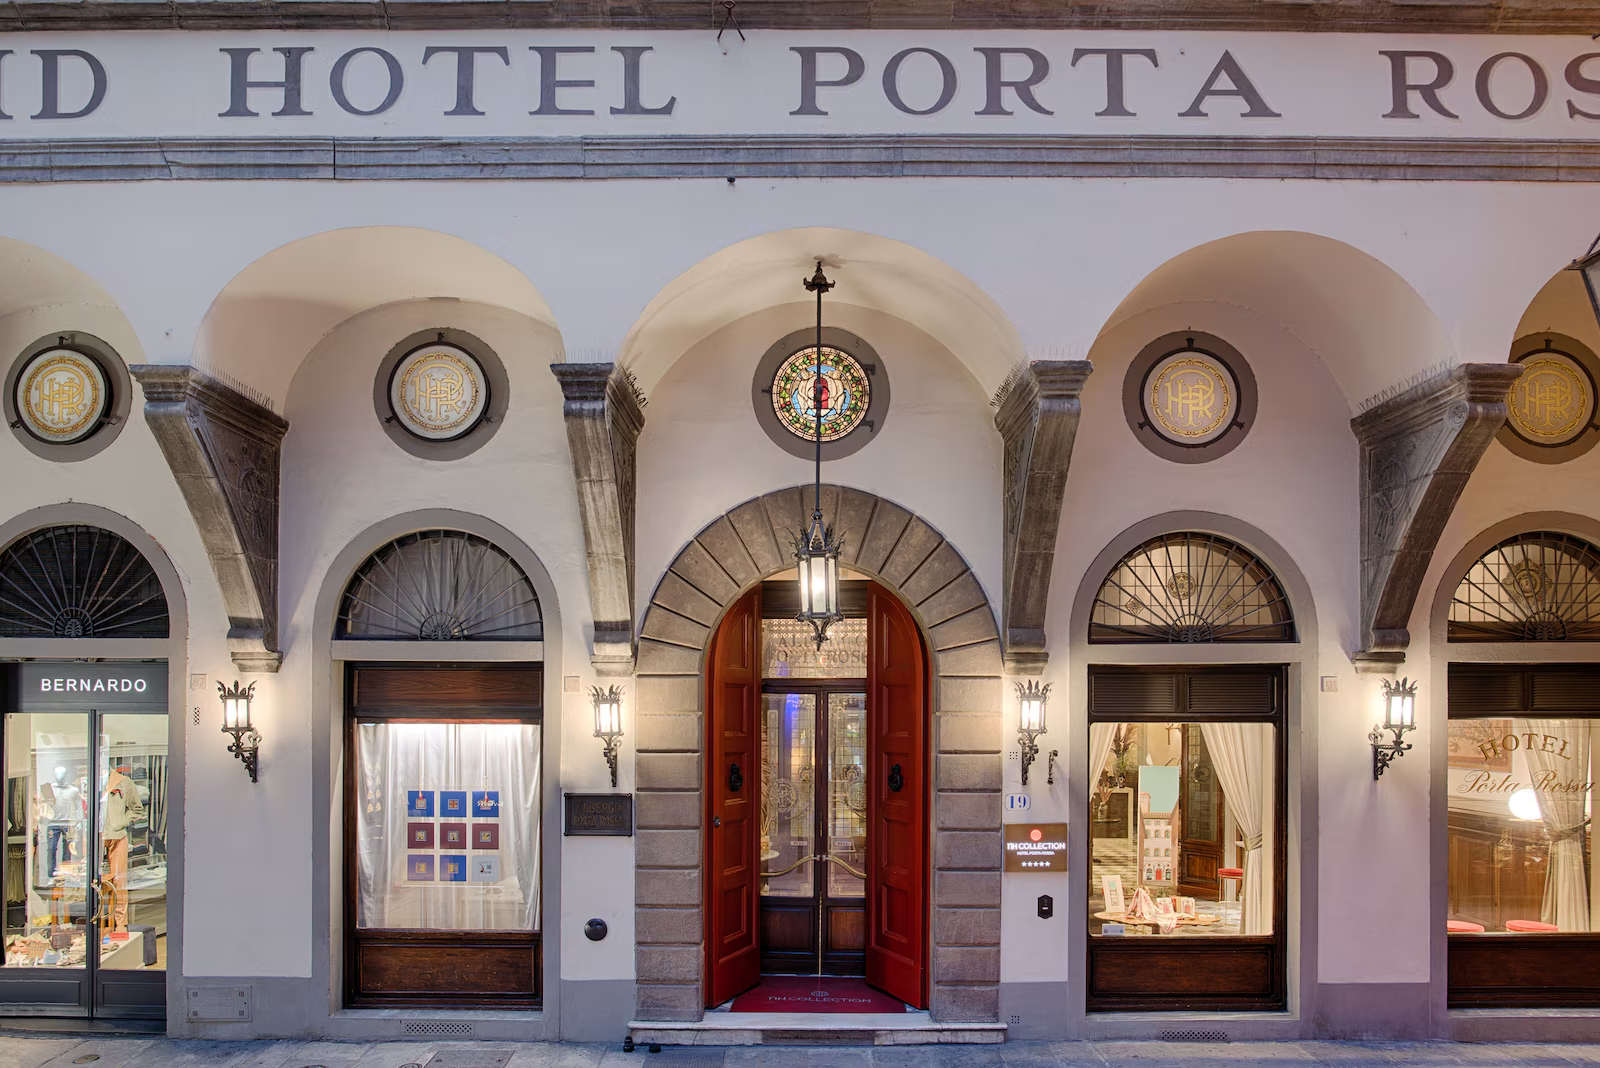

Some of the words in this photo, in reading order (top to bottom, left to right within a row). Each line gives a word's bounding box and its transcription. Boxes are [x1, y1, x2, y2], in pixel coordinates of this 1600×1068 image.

[0, 49, 107, 119] D
[217, 46, 677, 118] HOTEL
[789, 46, 1282, 118] PORTA
[1378, 50, 1600, 120] ROS
[41, 678, 147, 692] BERNARDO
[1478, 733, 1572, 760] HOTEL
[1457, 769, 1520, 793] Porta
[1522, 769, 1596, 793] Rossa
[575, 801, 622, 814] ALBERGO
[1010, 795, 1027, 808] 19
[573, 816, 597, 827] PORTA
[600, 816, 625, 827] ROSSA
[1018, 842, 1066, 850] COLLECTION
